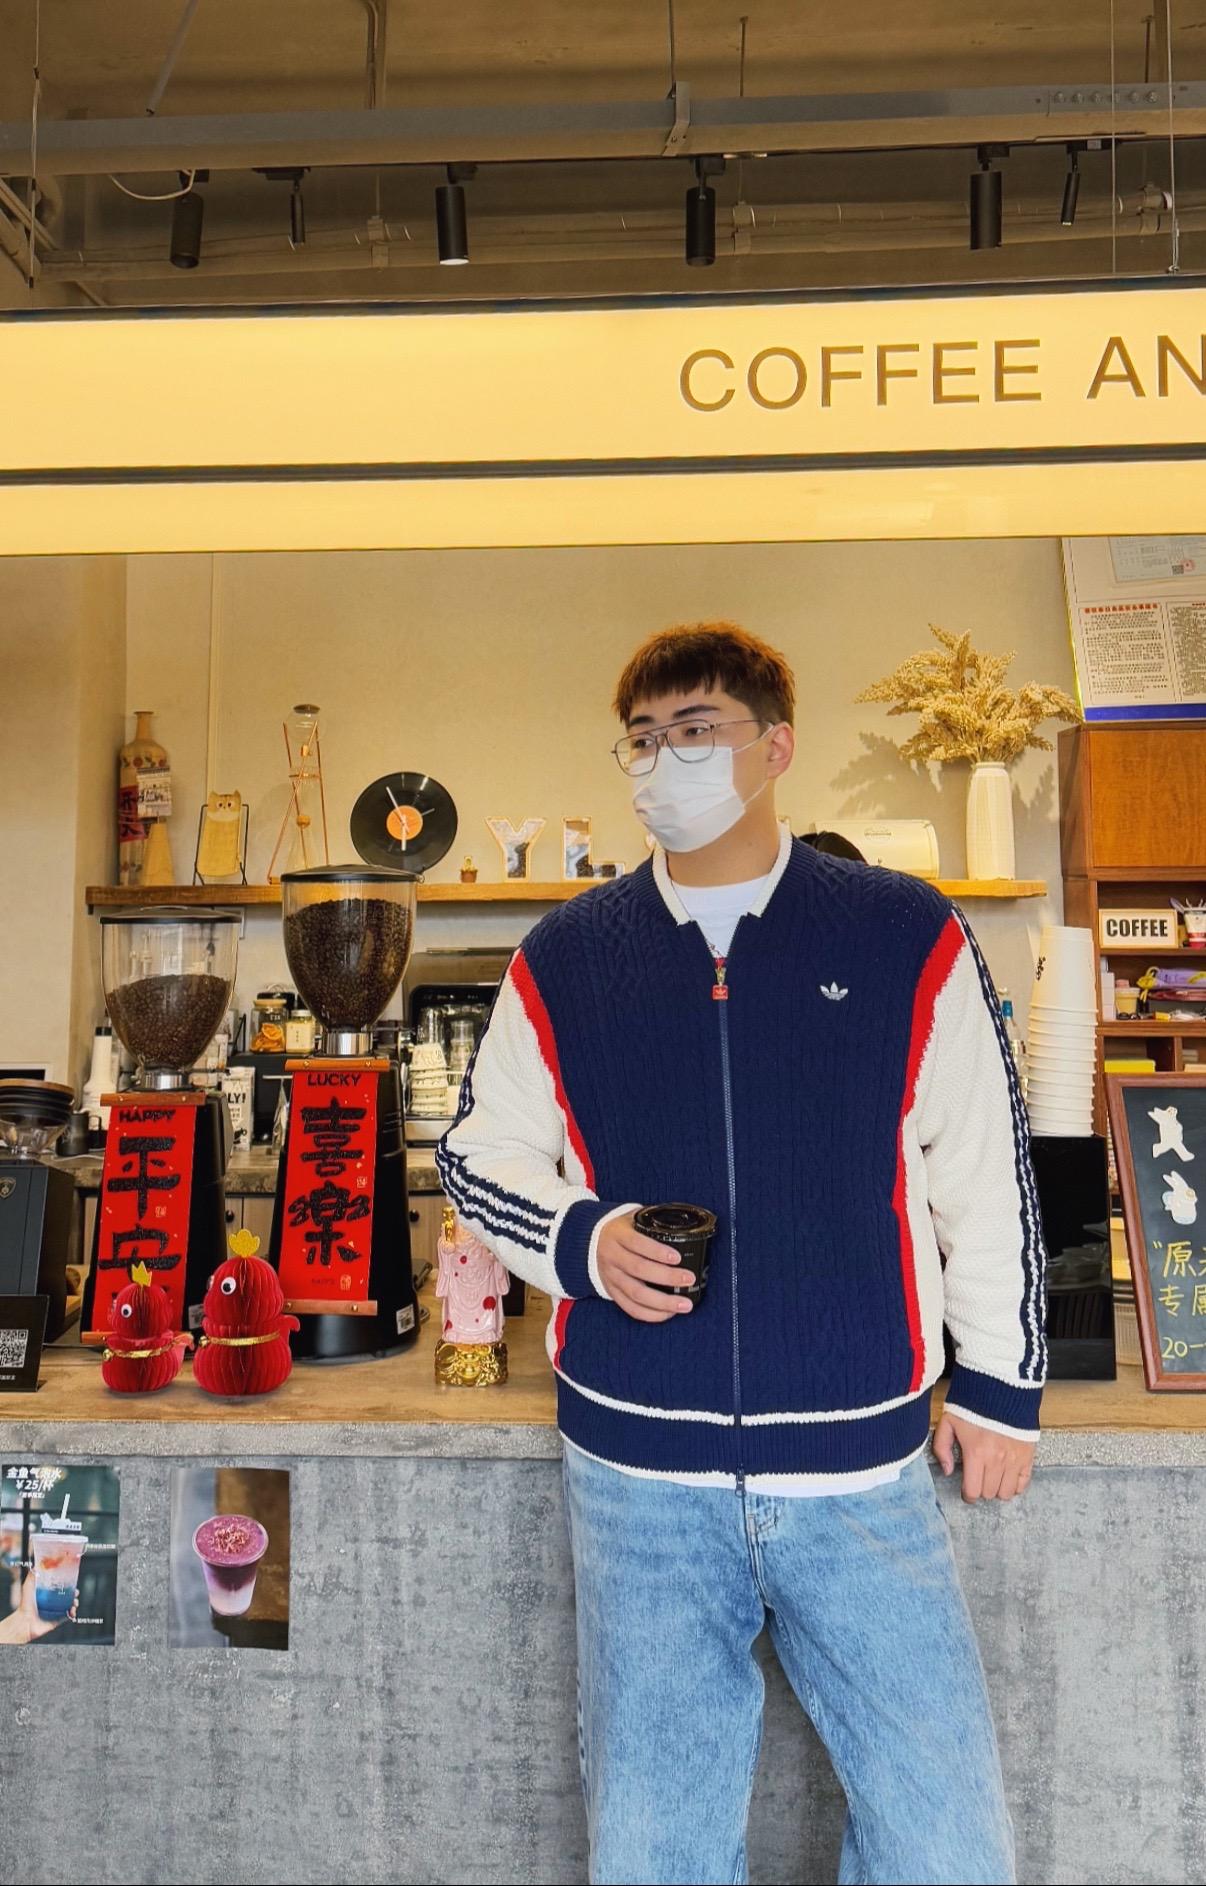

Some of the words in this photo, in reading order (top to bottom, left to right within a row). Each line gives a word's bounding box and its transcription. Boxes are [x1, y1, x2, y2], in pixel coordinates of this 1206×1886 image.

[680, 339, 1042, 412] COFFEE
[1106, 918, 1168, 938] COFFEE
[307, 1073, 361, 1087] LUCKY
[118, 1109, 176, 1123] HAPPY
